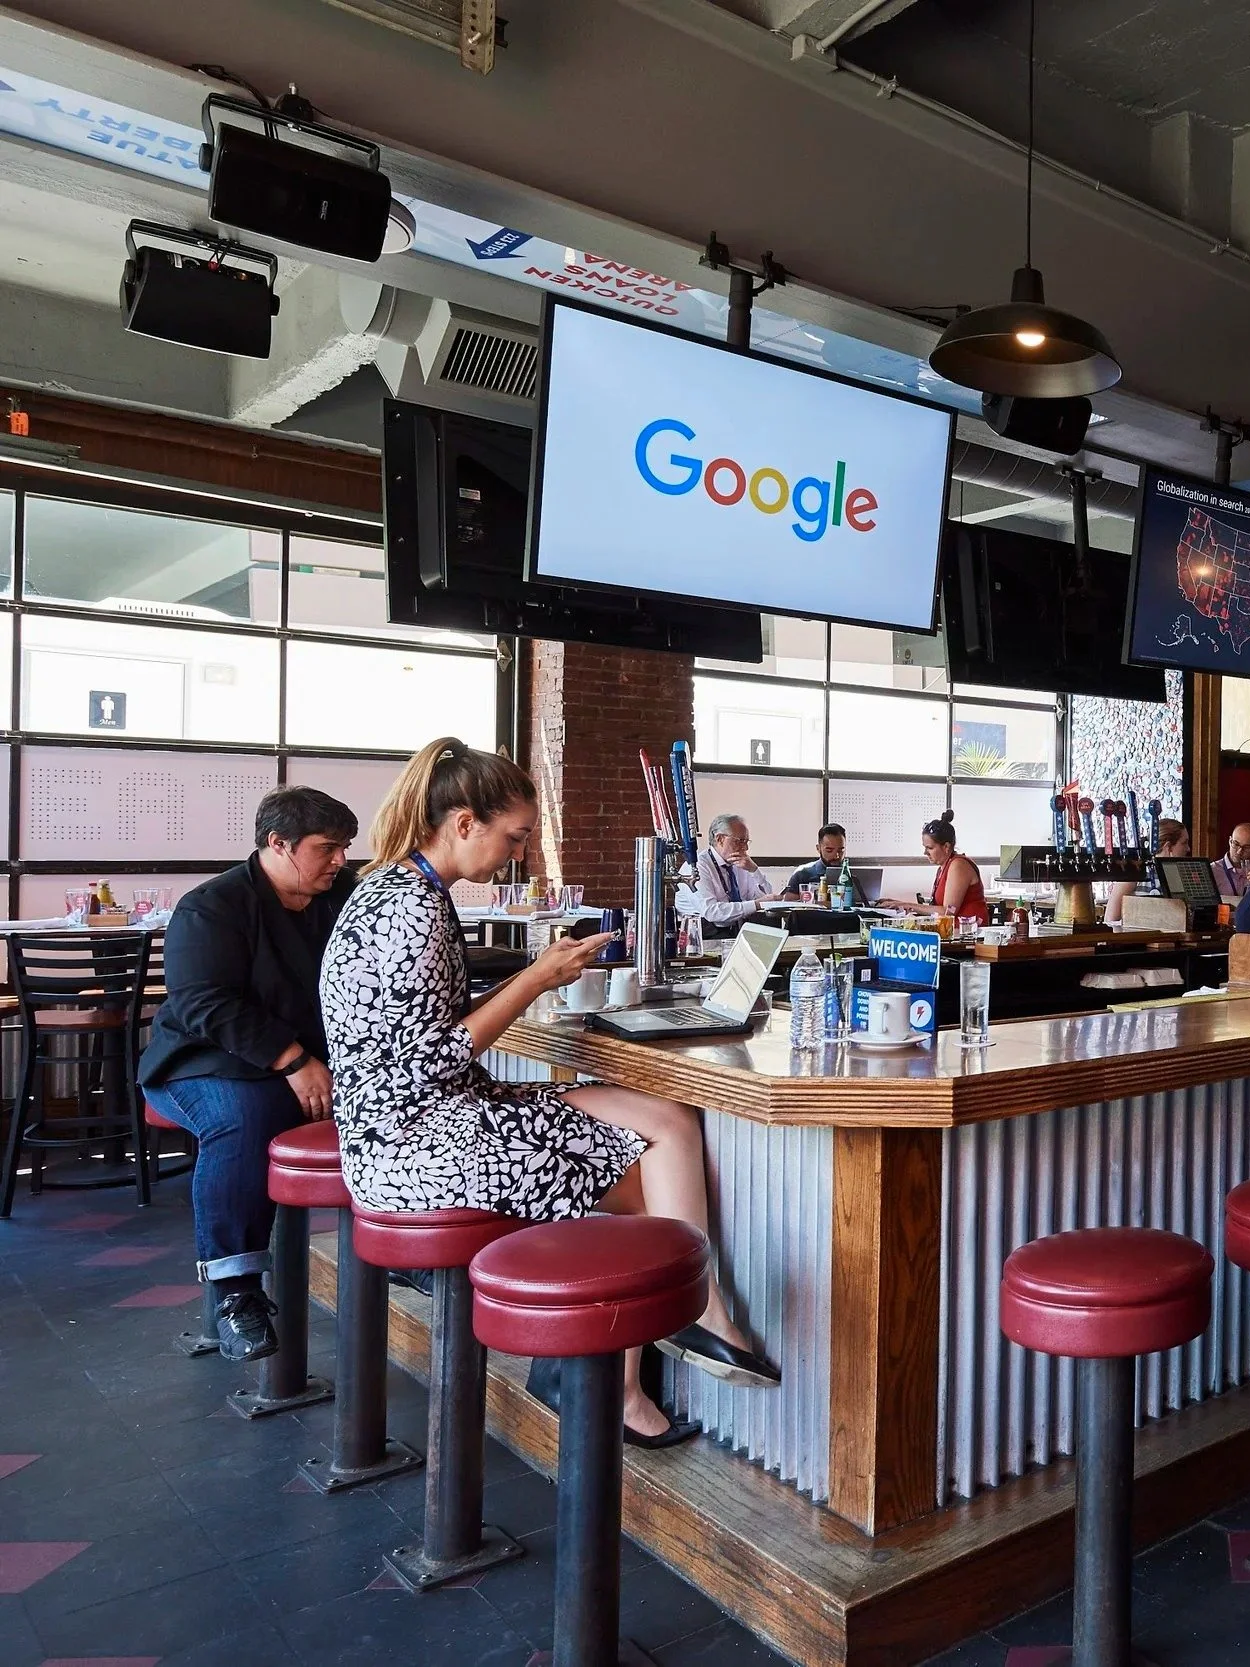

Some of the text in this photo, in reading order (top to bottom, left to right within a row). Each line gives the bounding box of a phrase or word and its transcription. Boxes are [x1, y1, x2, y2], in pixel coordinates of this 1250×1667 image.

[35, 98, 193, 151] BERTY
[86, 130, 199, 169] ATUE
[523, 266, 679, 316] QUICKEN
[563, 264, 678, 302] LOANS
[584, 253, 695, 292] ARENA
[634, 418, 879, 543] Google
[1157, 480, 1209, 503] Globalization
[1210, 494, 1218, 505] in
[1218, 498, 1244, 512] search
[871, 938, 938, 963] WELCOME
